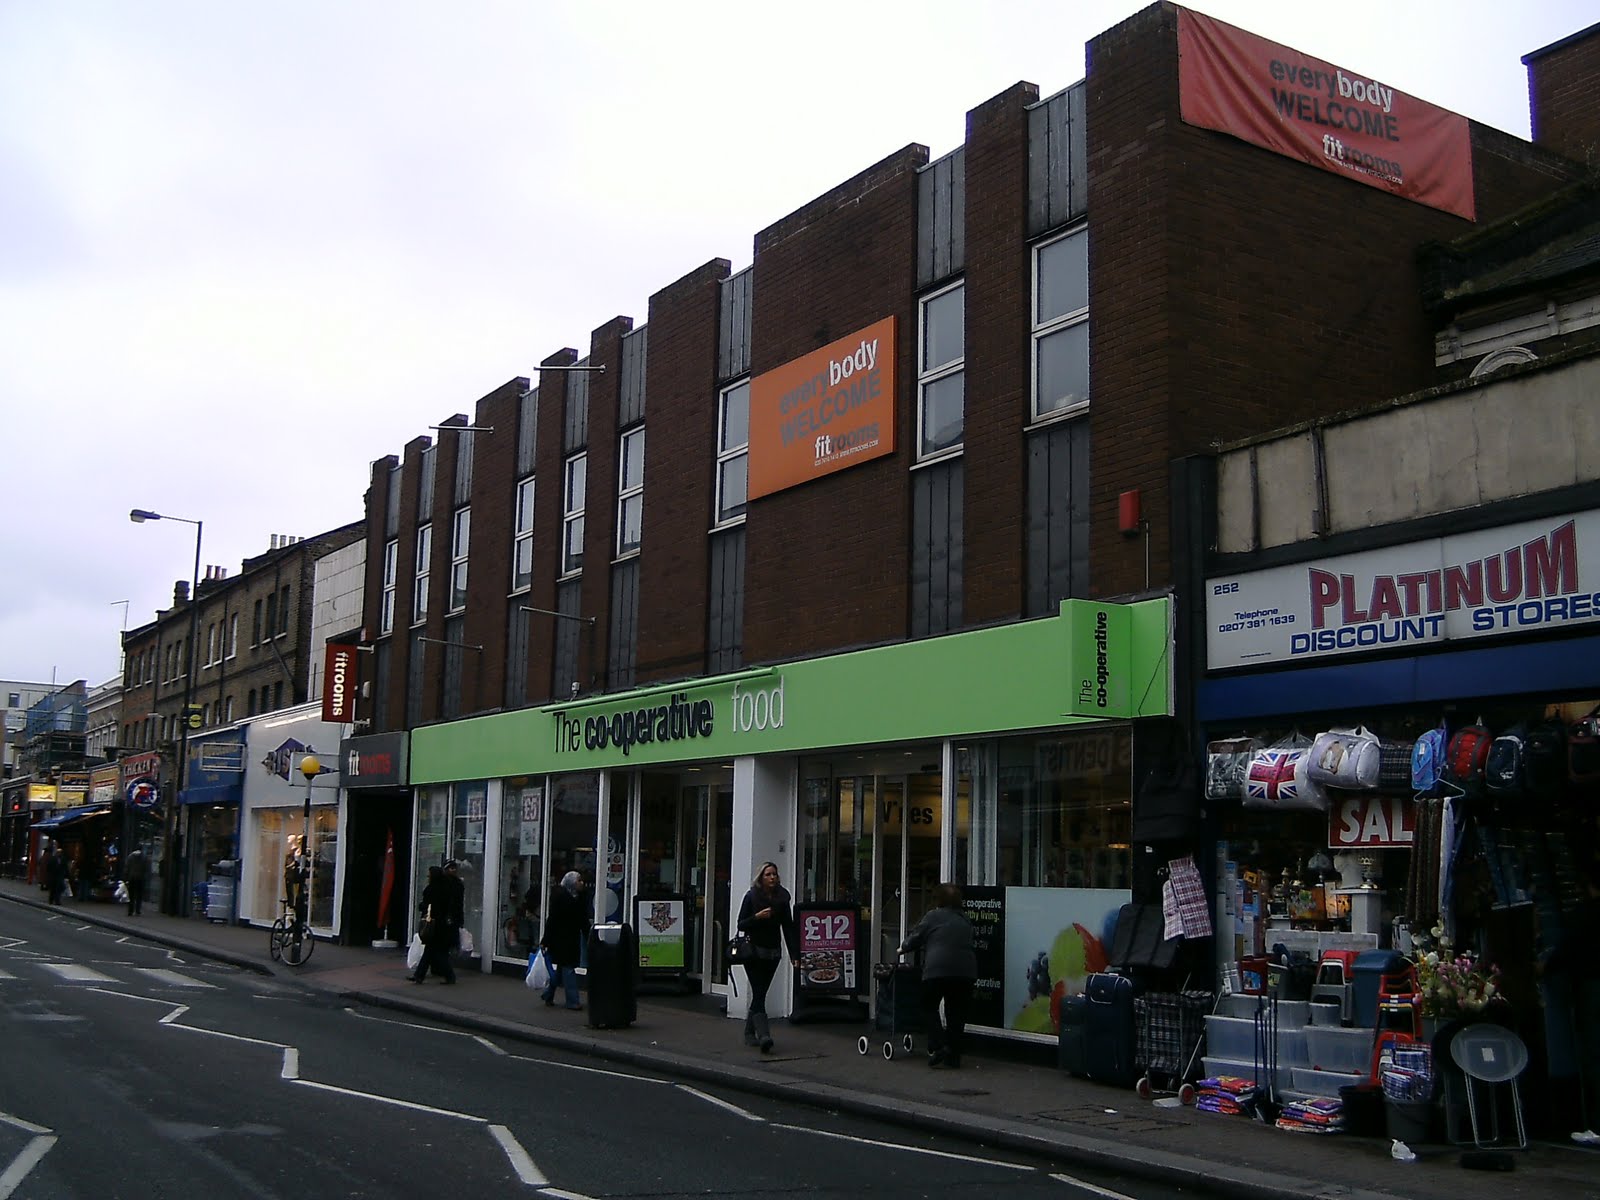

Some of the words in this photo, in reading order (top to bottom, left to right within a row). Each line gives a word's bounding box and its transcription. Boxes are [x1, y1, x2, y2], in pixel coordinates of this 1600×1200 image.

[1269, 59, 1393, 112] everybody
[1269, 87, 1400, 142] WELCOME
[779, 338, 878, 415] everybody
[779, 368, 881, 448] WELCOME
[815, 422, 879, 459] fitrooms
[1213, 582, 1239, 595] 252
[1308, 519, 1579, 630] PLATINUM
[1218, 622, 1246, 633] 0207
[1247, 619, 1266, 630] 381
[1269, 614, 1295, 626] 1639
[1234, 607, 1278, 620] Telephone
[1290, 615, 1444, 654] DISCOUNT
[1472, 592, 1600, 631] STORES
[332, 651, 349, 716] fitrooms
[1094, 611, 1110, 708] co-operative
[553, 711, 581, 753] The
[731, 674, 784, 733] food
[1079, 679, 1092, 704] The
[1340, 800, 1413, 844] SAL
[804, 914, 850, 941] £12
[966, 898, 1002, 910] co-operative
